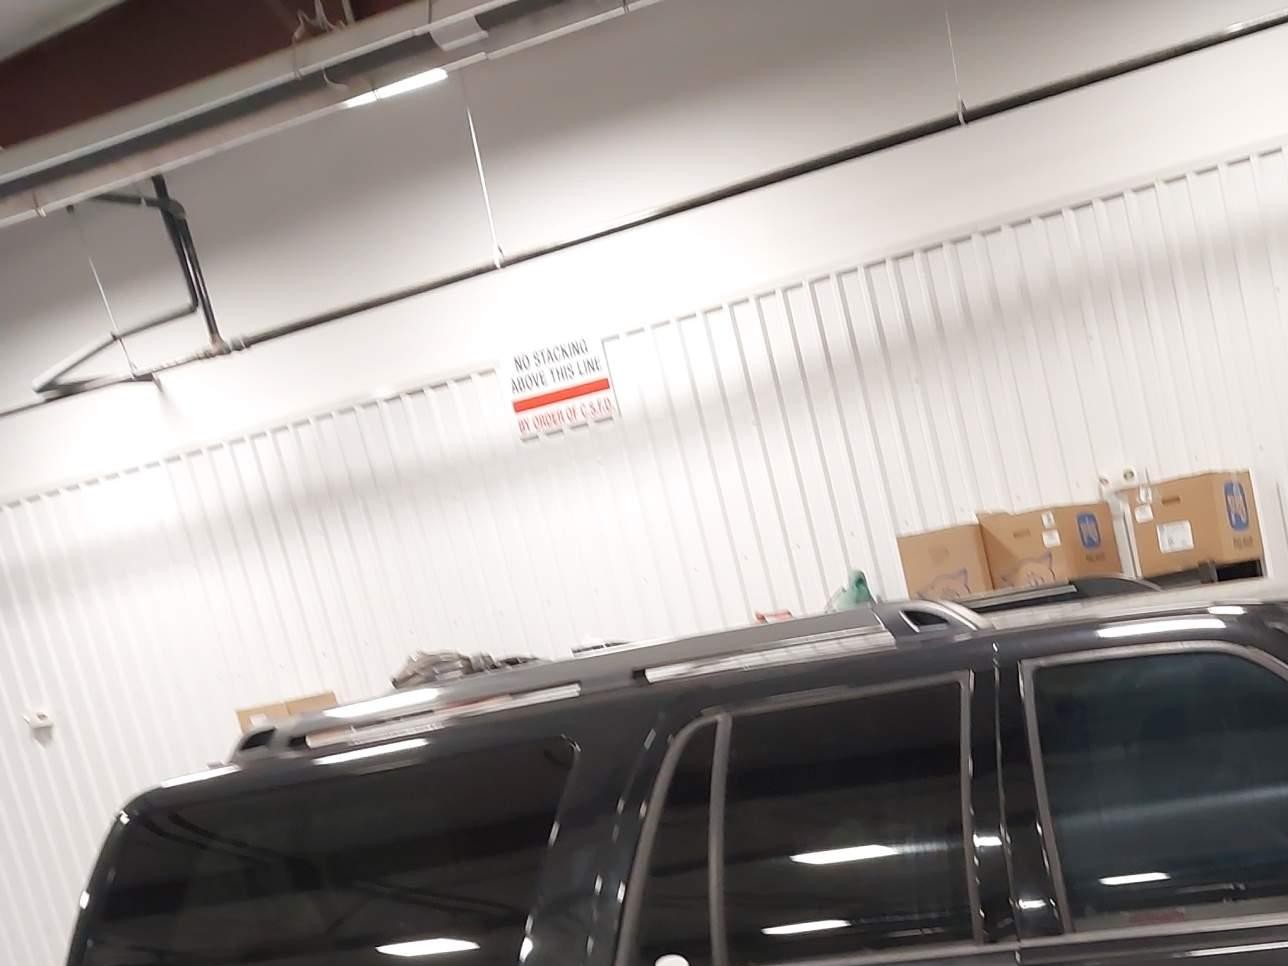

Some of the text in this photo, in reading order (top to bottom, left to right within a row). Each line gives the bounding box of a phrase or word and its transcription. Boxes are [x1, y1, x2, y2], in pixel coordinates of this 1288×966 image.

[514, 339, 588, 373] NO STACKING
[511, 356, 600, 393] ABOVE THIS LINE
[519, 419, 530, 432] BY
[533, 410, 564, 430] ORDER
[566, 406, 578, 422] OF
